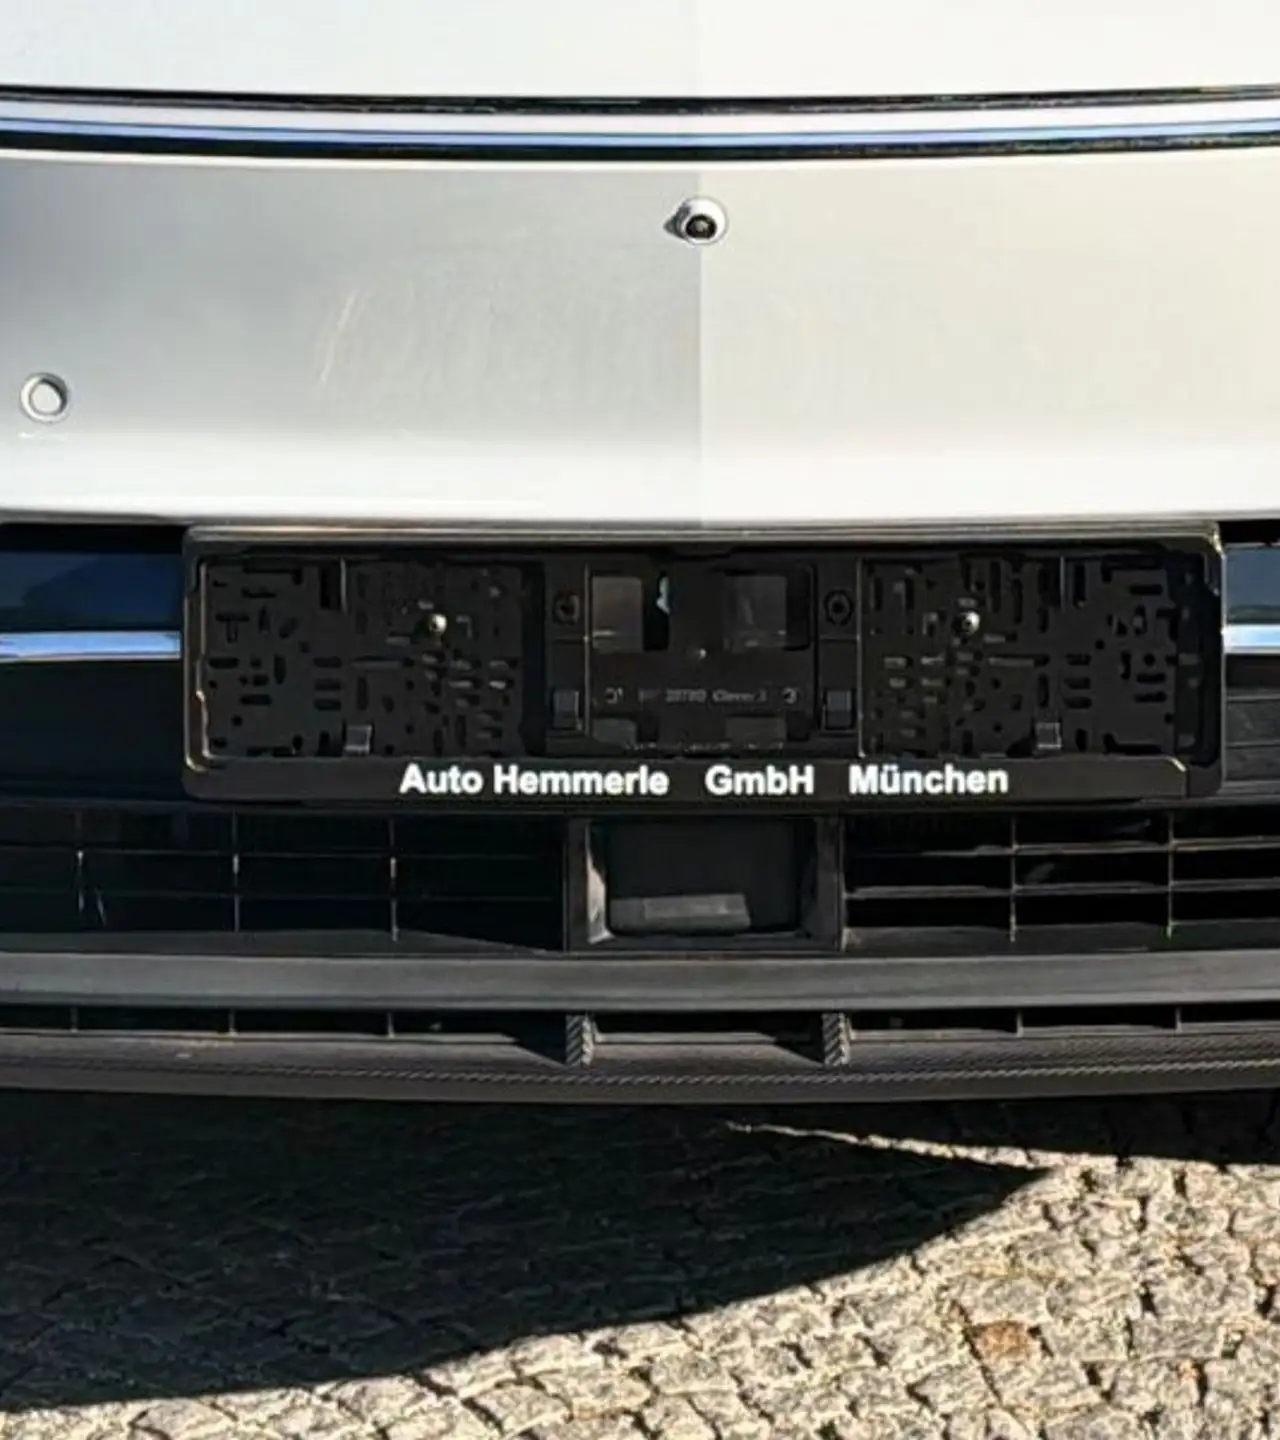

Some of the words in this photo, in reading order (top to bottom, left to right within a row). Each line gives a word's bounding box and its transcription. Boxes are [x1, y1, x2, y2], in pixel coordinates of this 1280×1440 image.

[399, 763, 483, 794] Auto
[492, 764, 670, 795] Hemmerle
[704, 764, 815, 795] GmbH
[848, 763, 1009, 795] München
